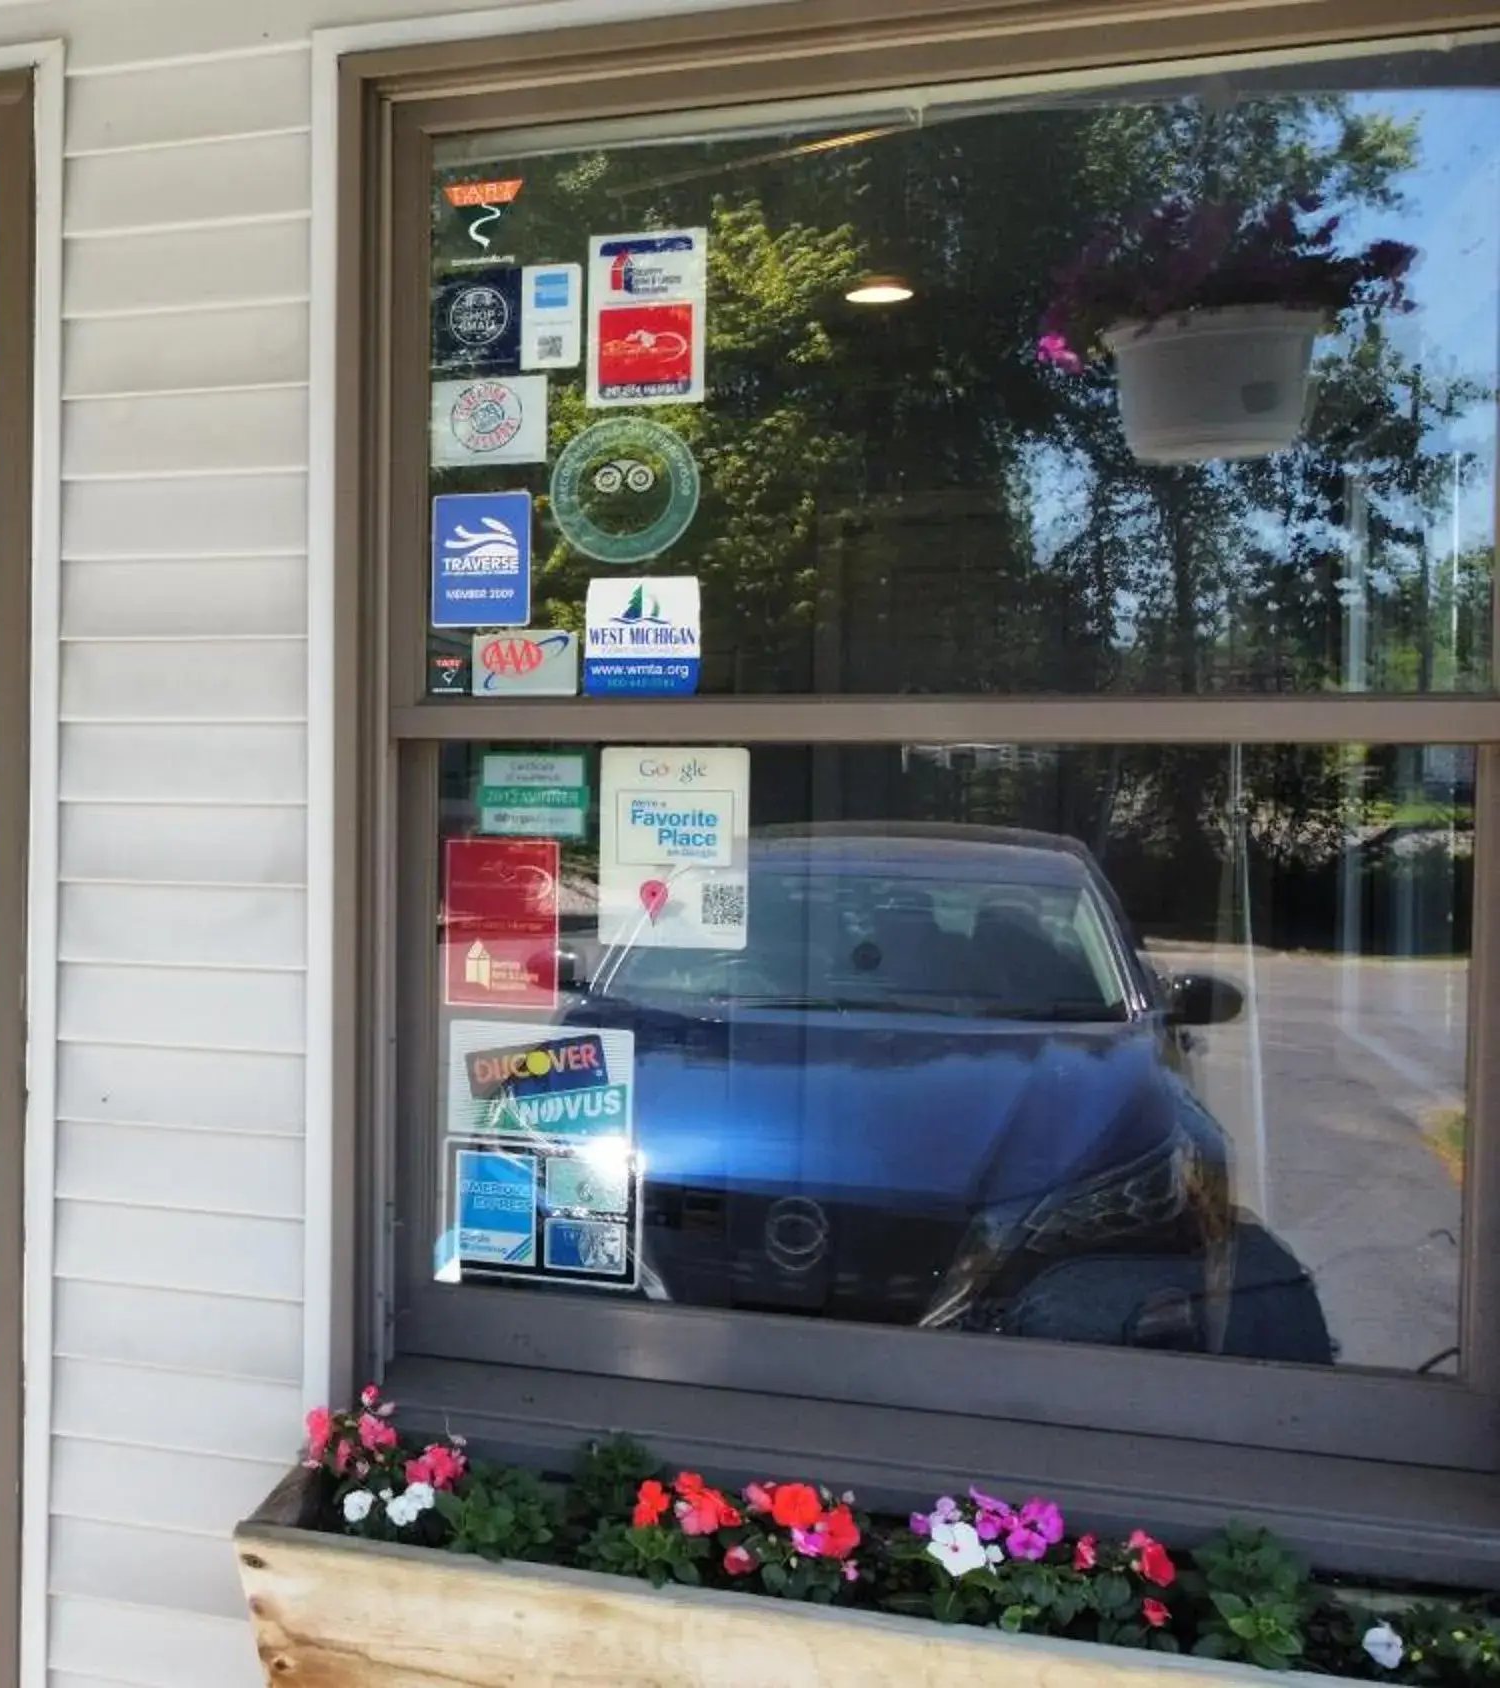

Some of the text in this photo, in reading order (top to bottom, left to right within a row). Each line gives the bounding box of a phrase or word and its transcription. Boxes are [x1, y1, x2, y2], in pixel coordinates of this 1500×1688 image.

[442, 556, 520, 572] TRAVERSE
[445, 588, 488, 600] MEMBER
[589, 627, 696, 645] WEST MICHIGAN
[483, 641, 542, 674] AAA
[591, 664, 690, 680] www.wmta.org
[639, 757, 708, 782] Gogle
[631, 808, 718, 827] Favorite
[658, 827, 717, 847] Place
[473, 1043, 599, 1084] DISCOVER
[519, 1089, 622, 1126] NOVUS
